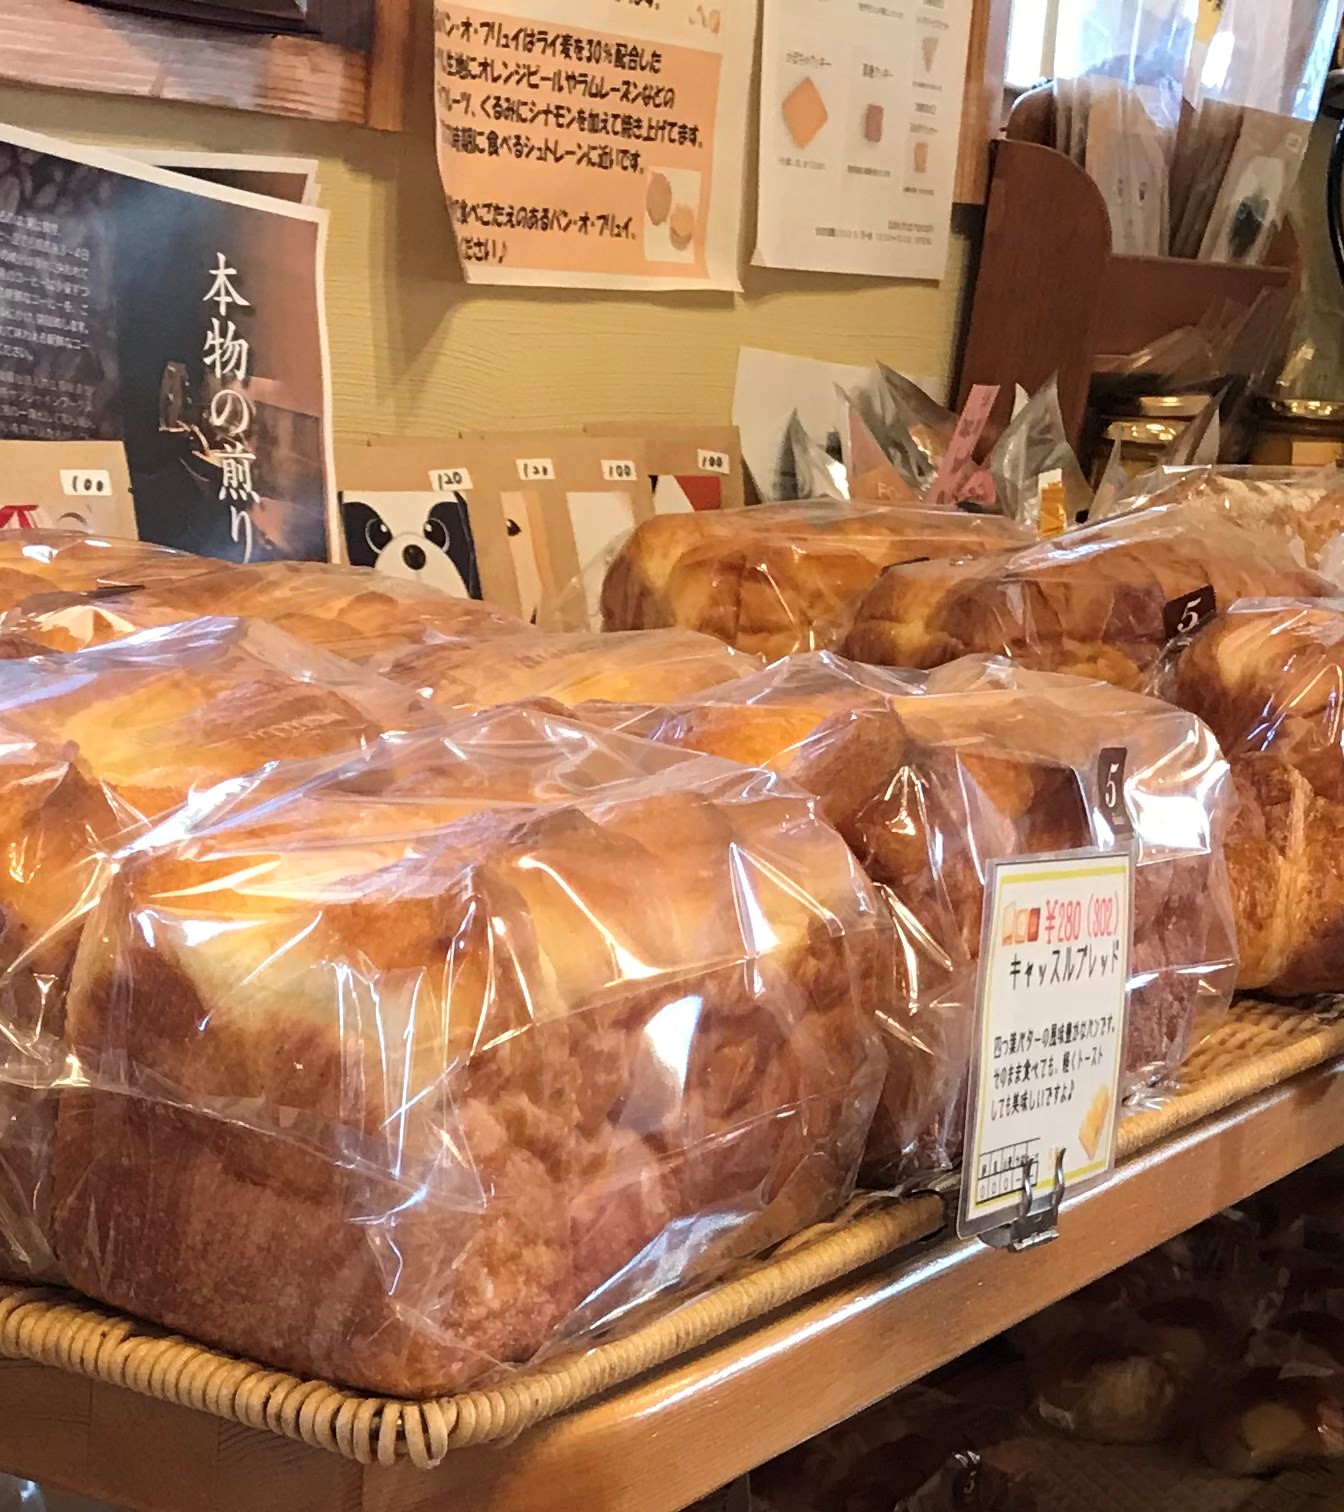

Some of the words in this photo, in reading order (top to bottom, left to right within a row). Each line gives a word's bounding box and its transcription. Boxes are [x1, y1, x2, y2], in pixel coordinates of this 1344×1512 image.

[71, 475, 105, 492] 100
[438, 473, 464, 490] 120
[608, 463, 632, 478] 100
[1175, 597, 1202, 633] 5
[1104, 763, 1119, 808] 5
[1044, 898, 1082, 945] ¥280
[1009, 939, 1121, 991] キャッスルブレッド
